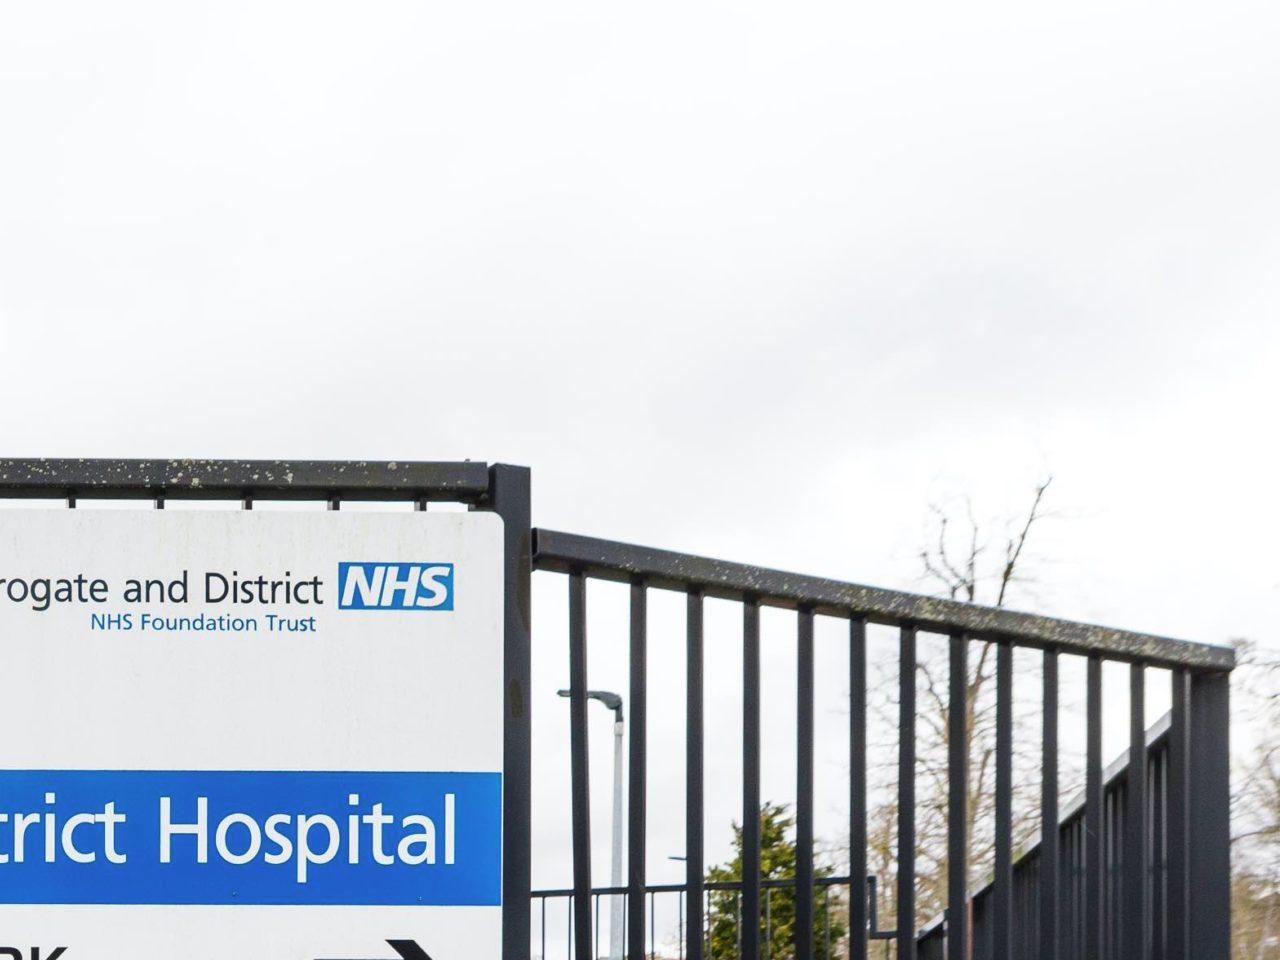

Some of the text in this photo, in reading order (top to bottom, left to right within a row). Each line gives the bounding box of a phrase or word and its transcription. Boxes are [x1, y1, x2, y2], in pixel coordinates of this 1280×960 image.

[123, 570, 189, 604] and
[205, 570, 324, 605] District
[341, 565, 450, 607] NHS
[91, 612, 317, 632] NHS Foundation Trust
[159, 793, 455, 883] Hospital
